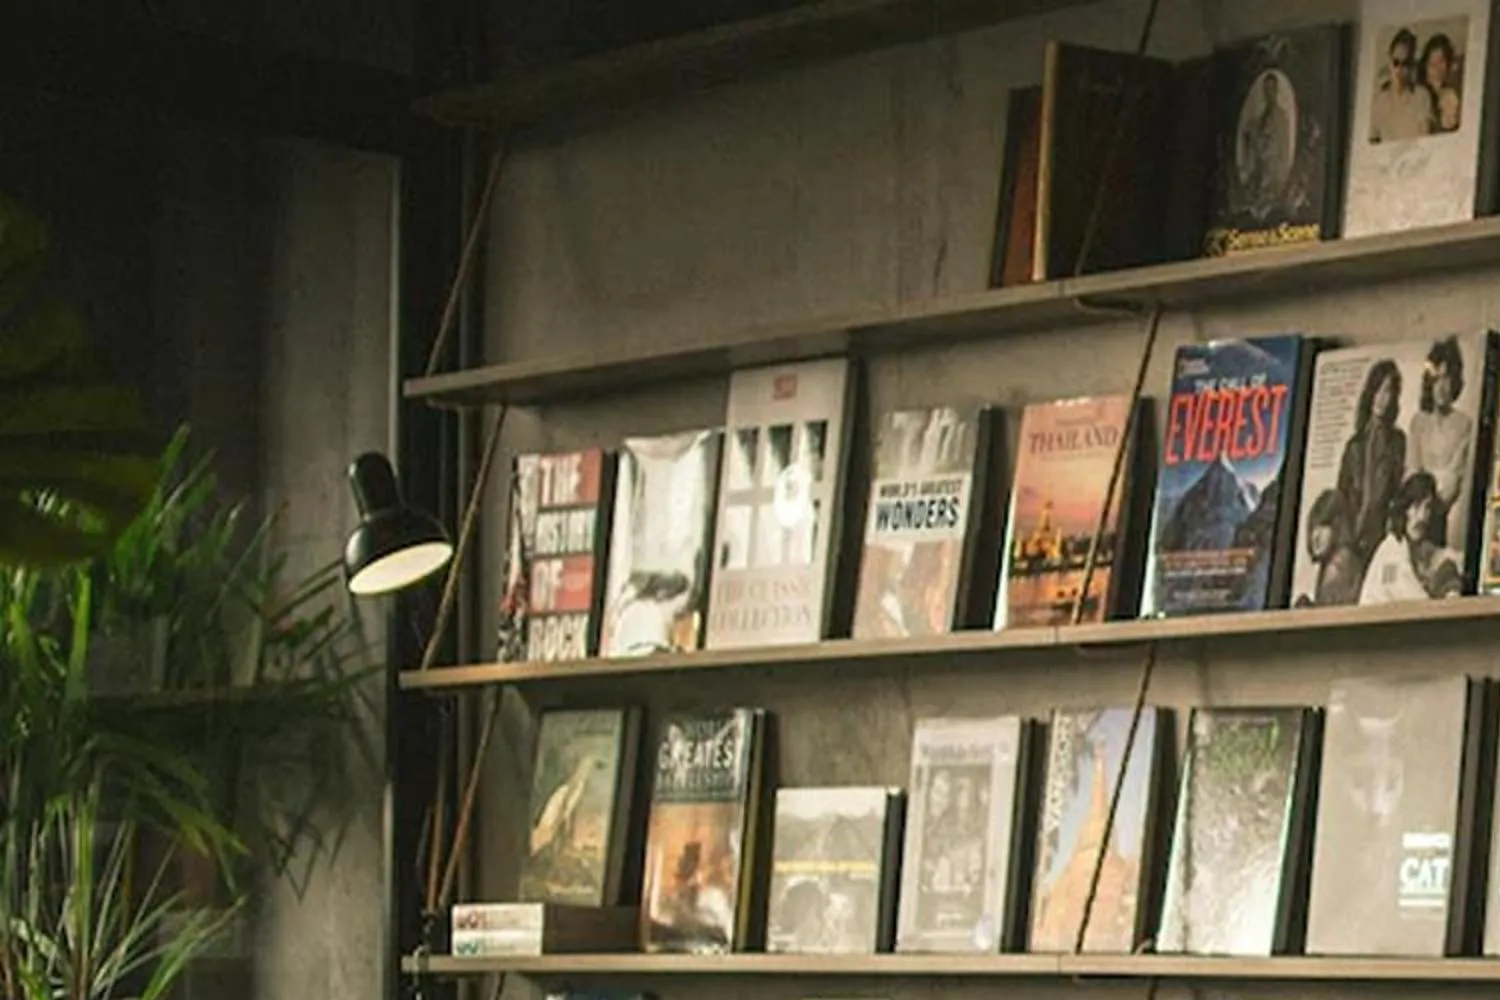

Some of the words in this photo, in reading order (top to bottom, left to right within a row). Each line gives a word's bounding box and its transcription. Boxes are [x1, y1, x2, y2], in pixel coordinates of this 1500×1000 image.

[1028, 425, 1119, 455] THAILAND
[1164, 383, 1288, 465] EVEREST
[541, 453, 583, 506] THE
[875, 496, 960, 531] WONDERS
[530, 557, 564, 612] OF
[527, 613, 588, 663] ROCK
[1399, 856, 1450, 894] CAT
